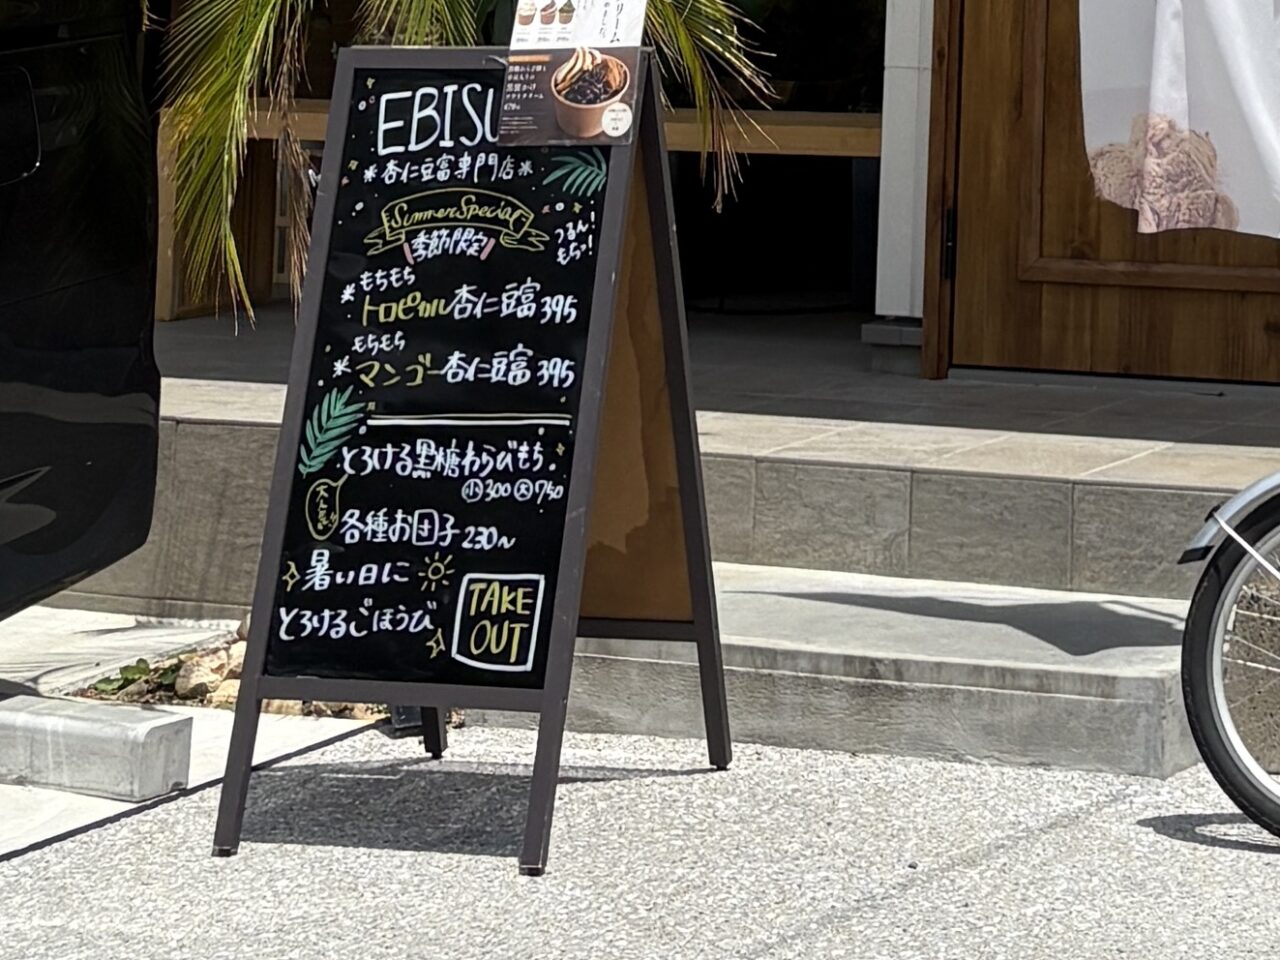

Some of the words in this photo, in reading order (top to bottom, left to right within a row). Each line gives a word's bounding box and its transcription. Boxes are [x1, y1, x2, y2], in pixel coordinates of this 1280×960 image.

[411, 227, 487, 262] 季節限定
[359, 266, 416, 291] もちもち
[540, 294, 578, 324] 395
[352, 331, 406, 356] もちもち
[537, 357, 576, 388] 395
[301, 549, 410, 591] 暑い日に
[468, 581, 533, 616] TAKE
[279, 598, 437, 640] とろけるごほうび
[470, 620, 530, 663] OUT
